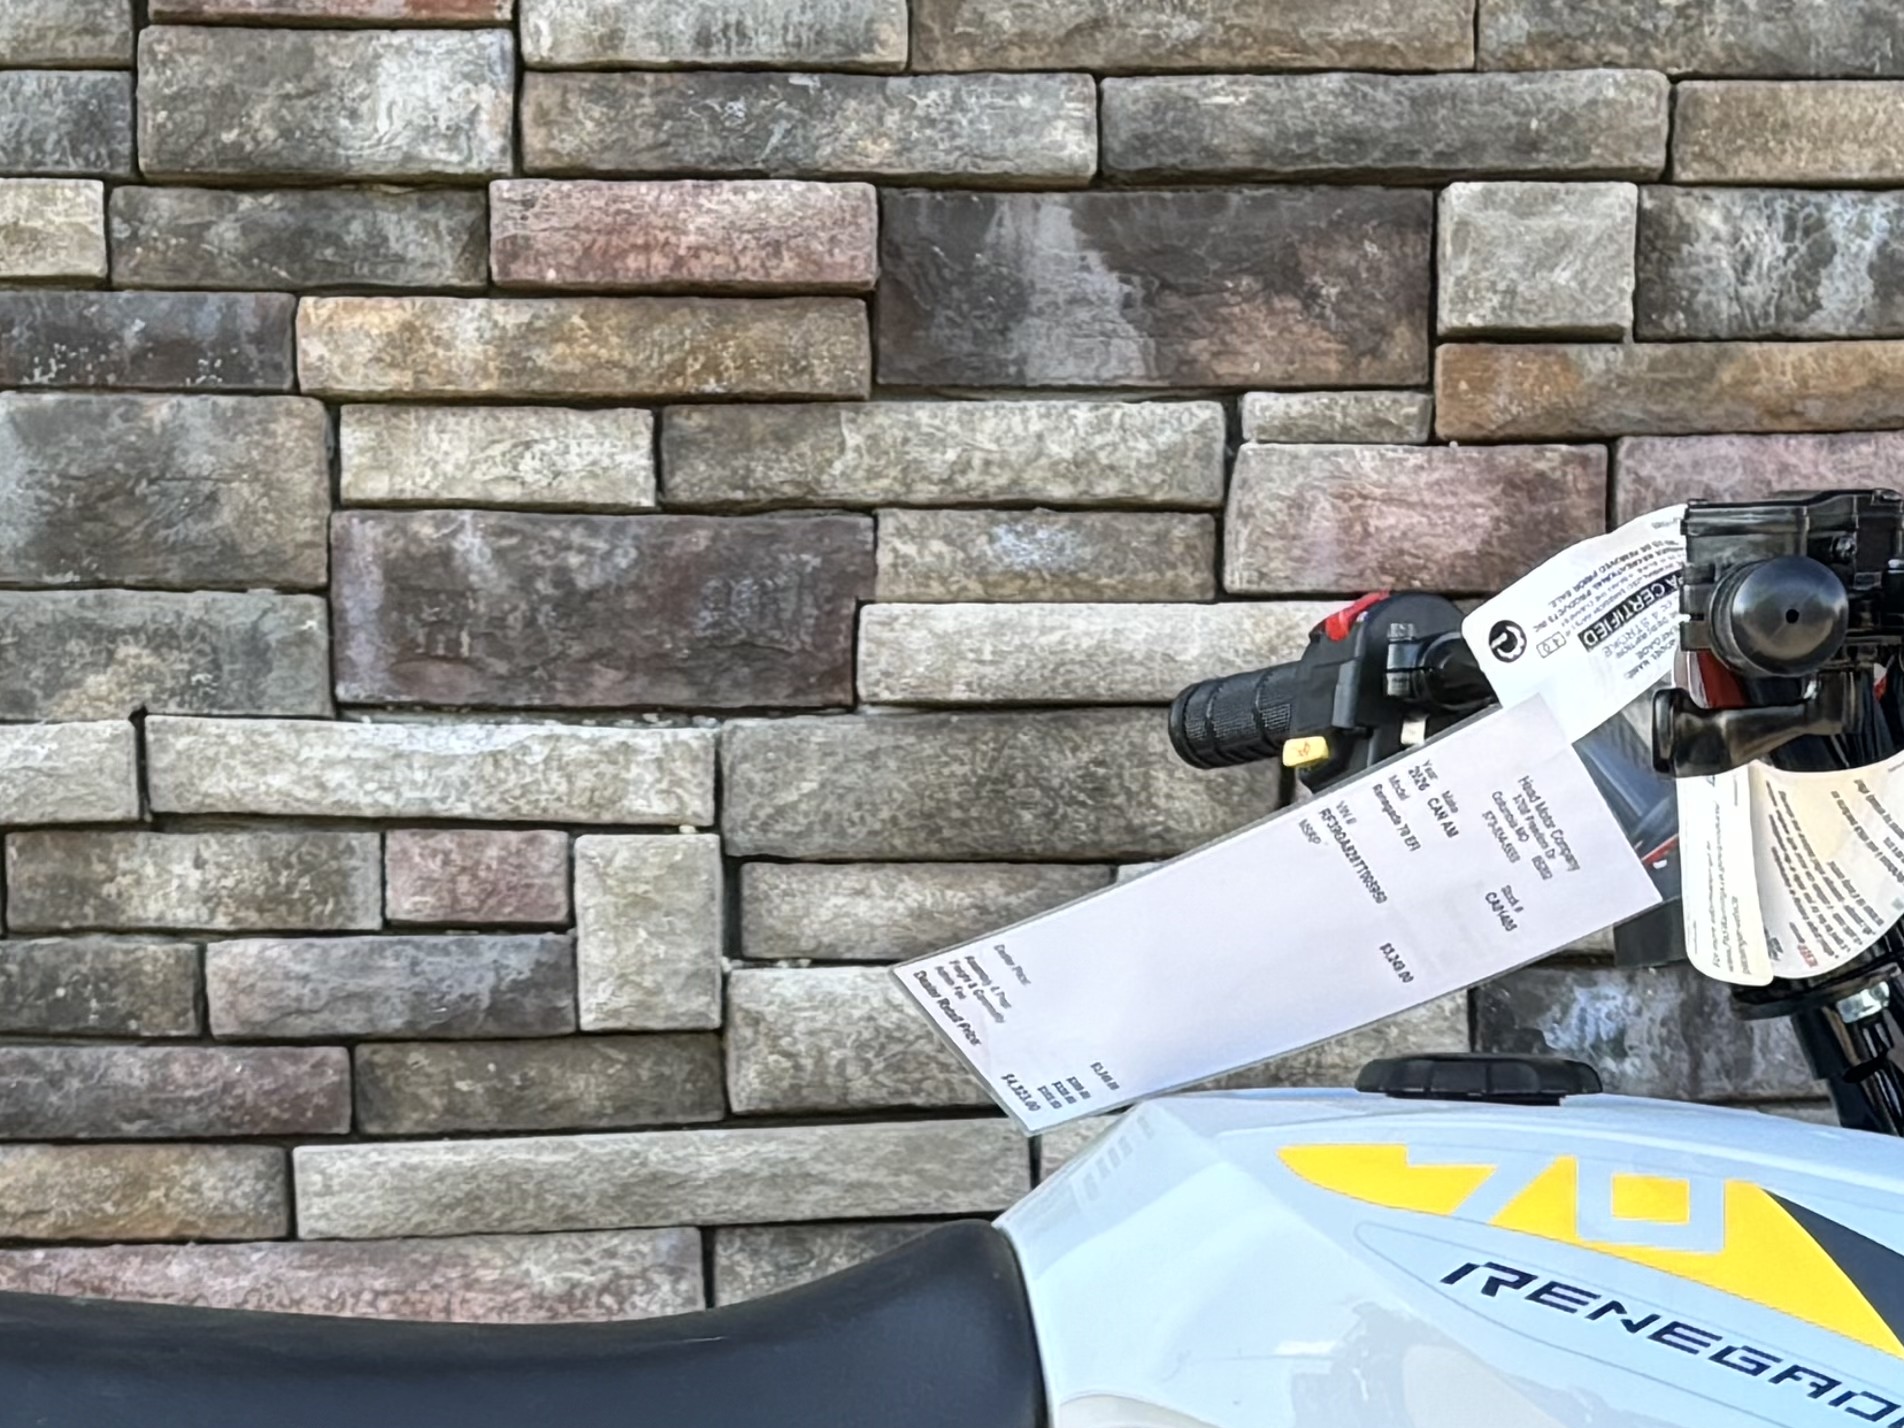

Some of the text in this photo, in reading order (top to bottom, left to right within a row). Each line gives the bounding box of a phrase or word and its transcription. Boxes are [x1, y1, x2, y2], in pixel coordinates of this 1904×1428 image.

[1579, 579, 1668, 648] CERTIFIED
[1600, 617, 1651, 657] STROKE
[1426, 795, 1449, 822] CAN
[1516, 774, 1583, 874] Head Motor Company
